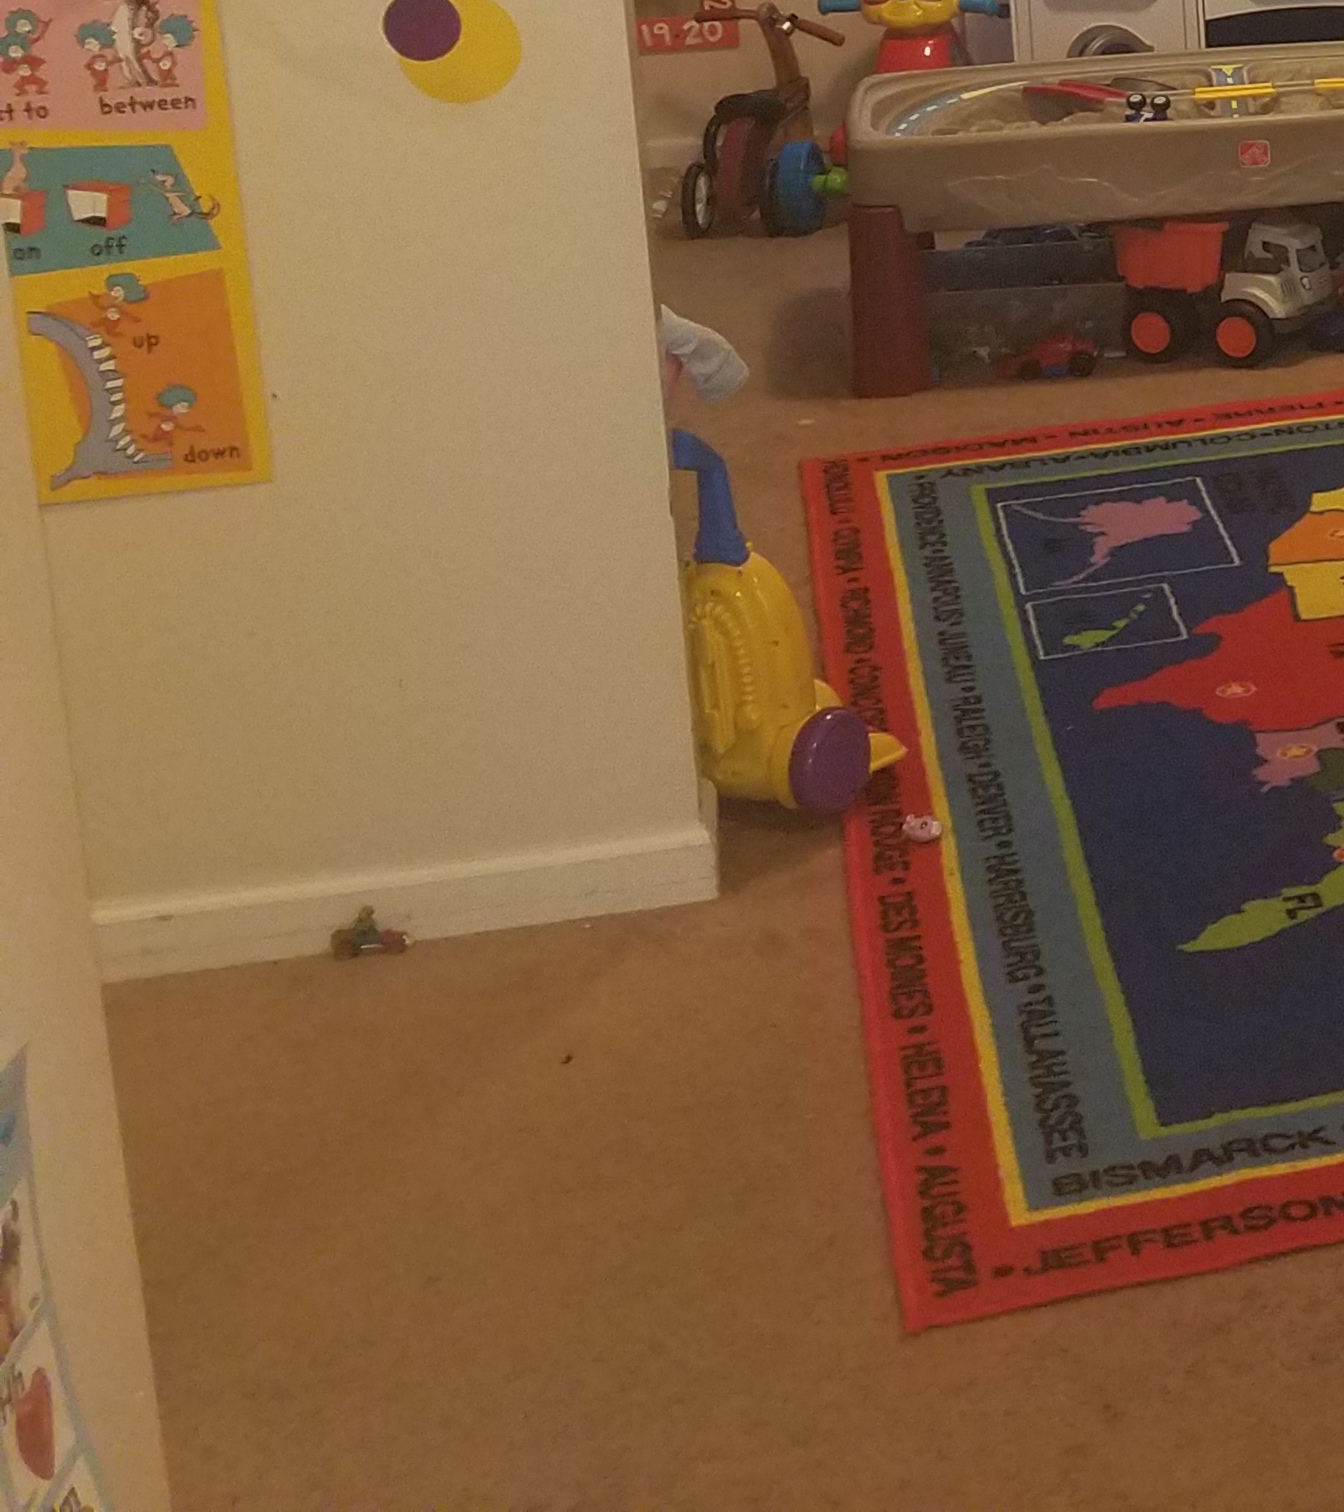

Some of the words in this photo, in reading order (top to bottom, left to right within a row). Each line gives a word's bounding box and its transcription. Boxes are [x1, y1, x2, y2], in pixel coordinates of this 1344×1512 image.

[639, 21, 672, 49] 19
[98, 93, 198, 118] between
[12, 243, 43, 263] on
[90, 234, 129, 258] off
[132, 331, 161, 355] up
[182, 440, 242, 465] down
[1279, 890, 1328, 920] FL
[897, 1037, 955, 1142] HELENA
[1011, 994, 1092, 1167] TALLAHASSEE
[1047, 1120, 1337, 1205] BISMARCK
[912, 1157, 979, 1299] AUGUSTA
